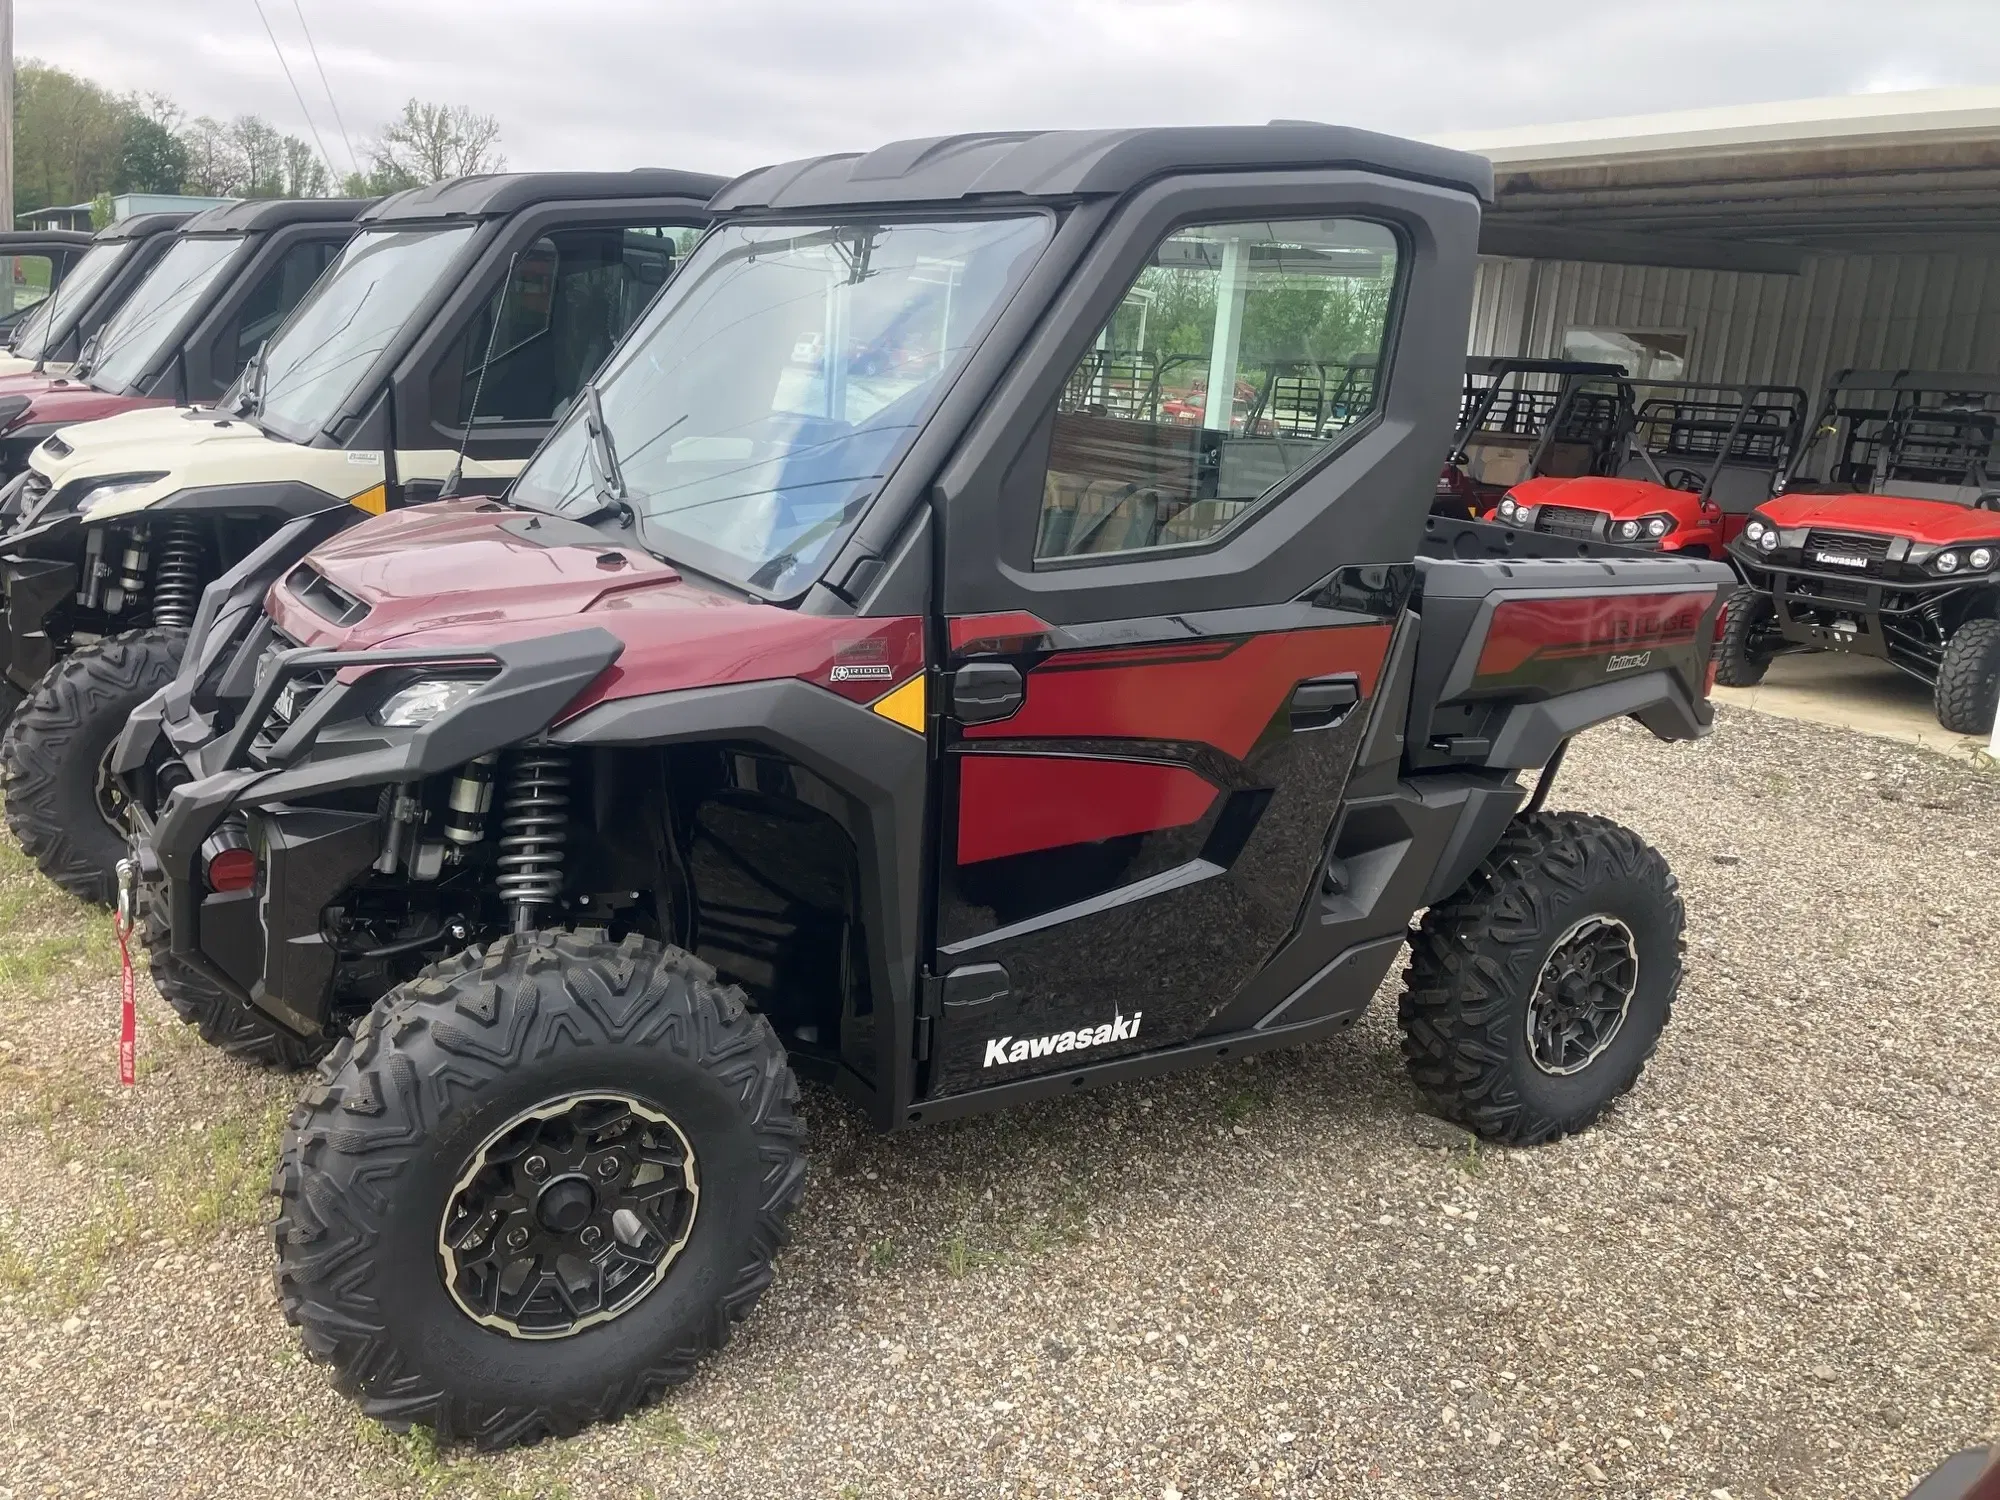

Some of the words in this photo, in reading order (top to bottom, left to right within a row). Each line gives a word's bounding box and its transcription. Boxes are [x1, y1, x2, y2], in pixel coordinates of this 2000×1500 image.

[1816, 552, 1868, 567] Kawasaki
[1613, 614, 1693, 635] RIDGE
[124, 966, 133, 1004] WARN
[983, 1012, 1143, 1068] Kawasaki
[121, 1041, 133, 1078] WARN
